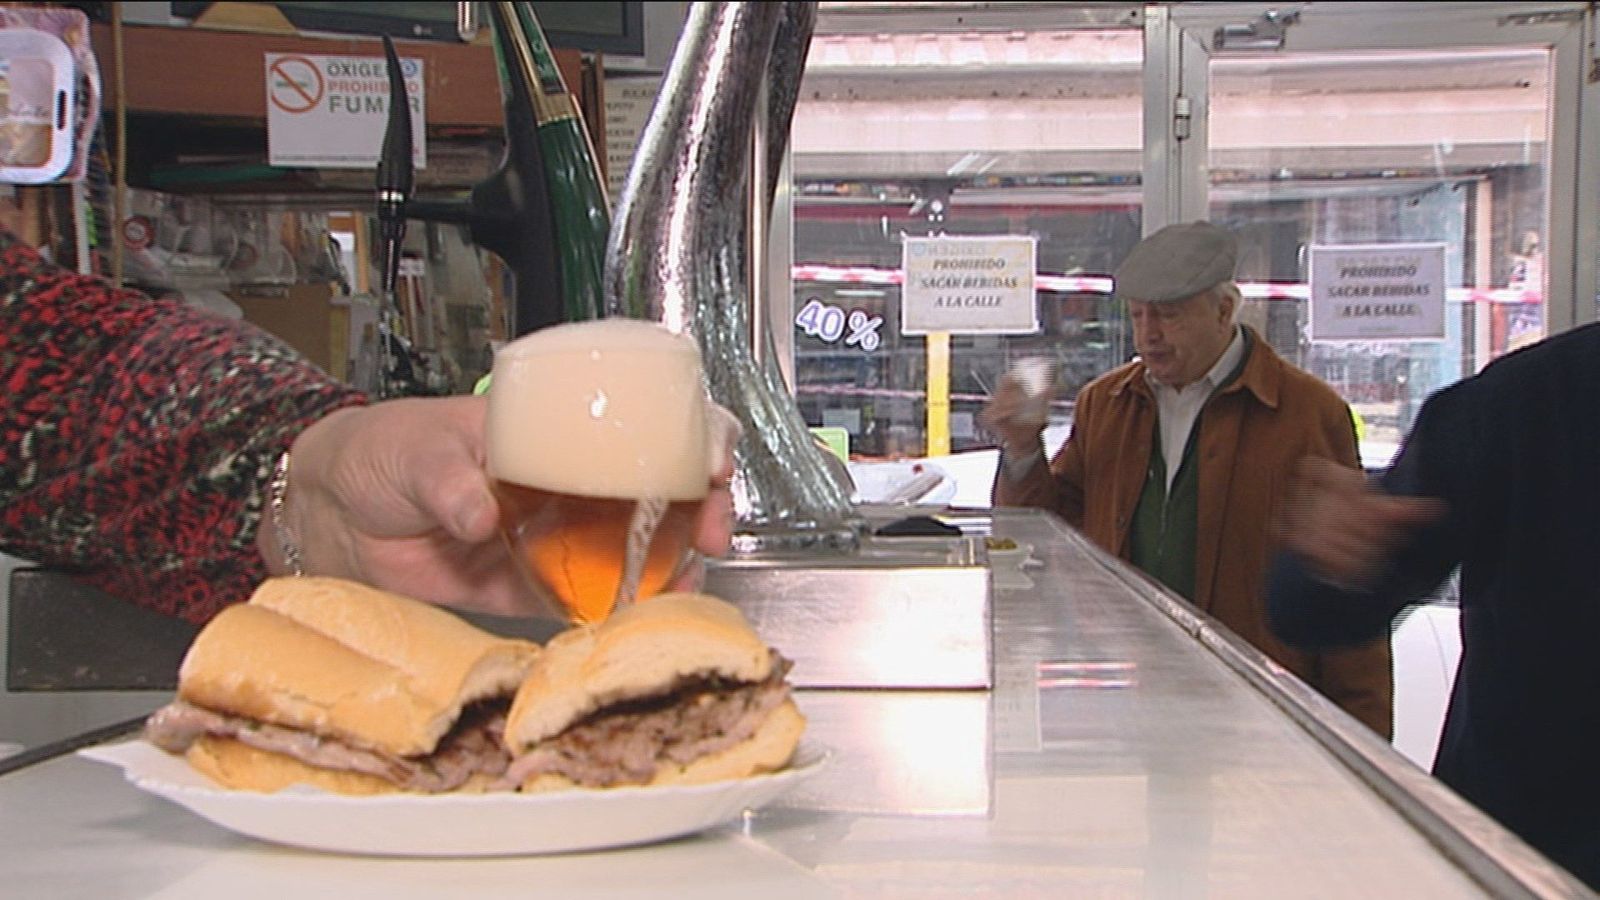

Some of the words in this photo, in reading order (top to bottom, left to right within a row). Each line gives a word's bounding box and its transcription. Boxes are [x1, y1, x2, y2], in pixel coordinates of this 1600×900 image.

[328, 80, 419, 93] PROHIBO
[329, 95, 420, 114] FUMR
[933, 257, 1006, 271] PROHIBIDO
[1340, 264, 1418, 279] PROHIBIDO
[920, 275, 962, 289] SACAR
[963, 276, 1019, 289] BEBIDAS
[1327, 285, 1371, 298] SACAR
[1372, 283, 1431, 297] BEBIDAS
[945, 296, 963, 308] LA
[964, 295, 1003, 307] CALLE
[1354, 303, 1372, 317] LA
[1373, 303, 1415, 317] CALLE
[796, 299, 883, 350] 40%
